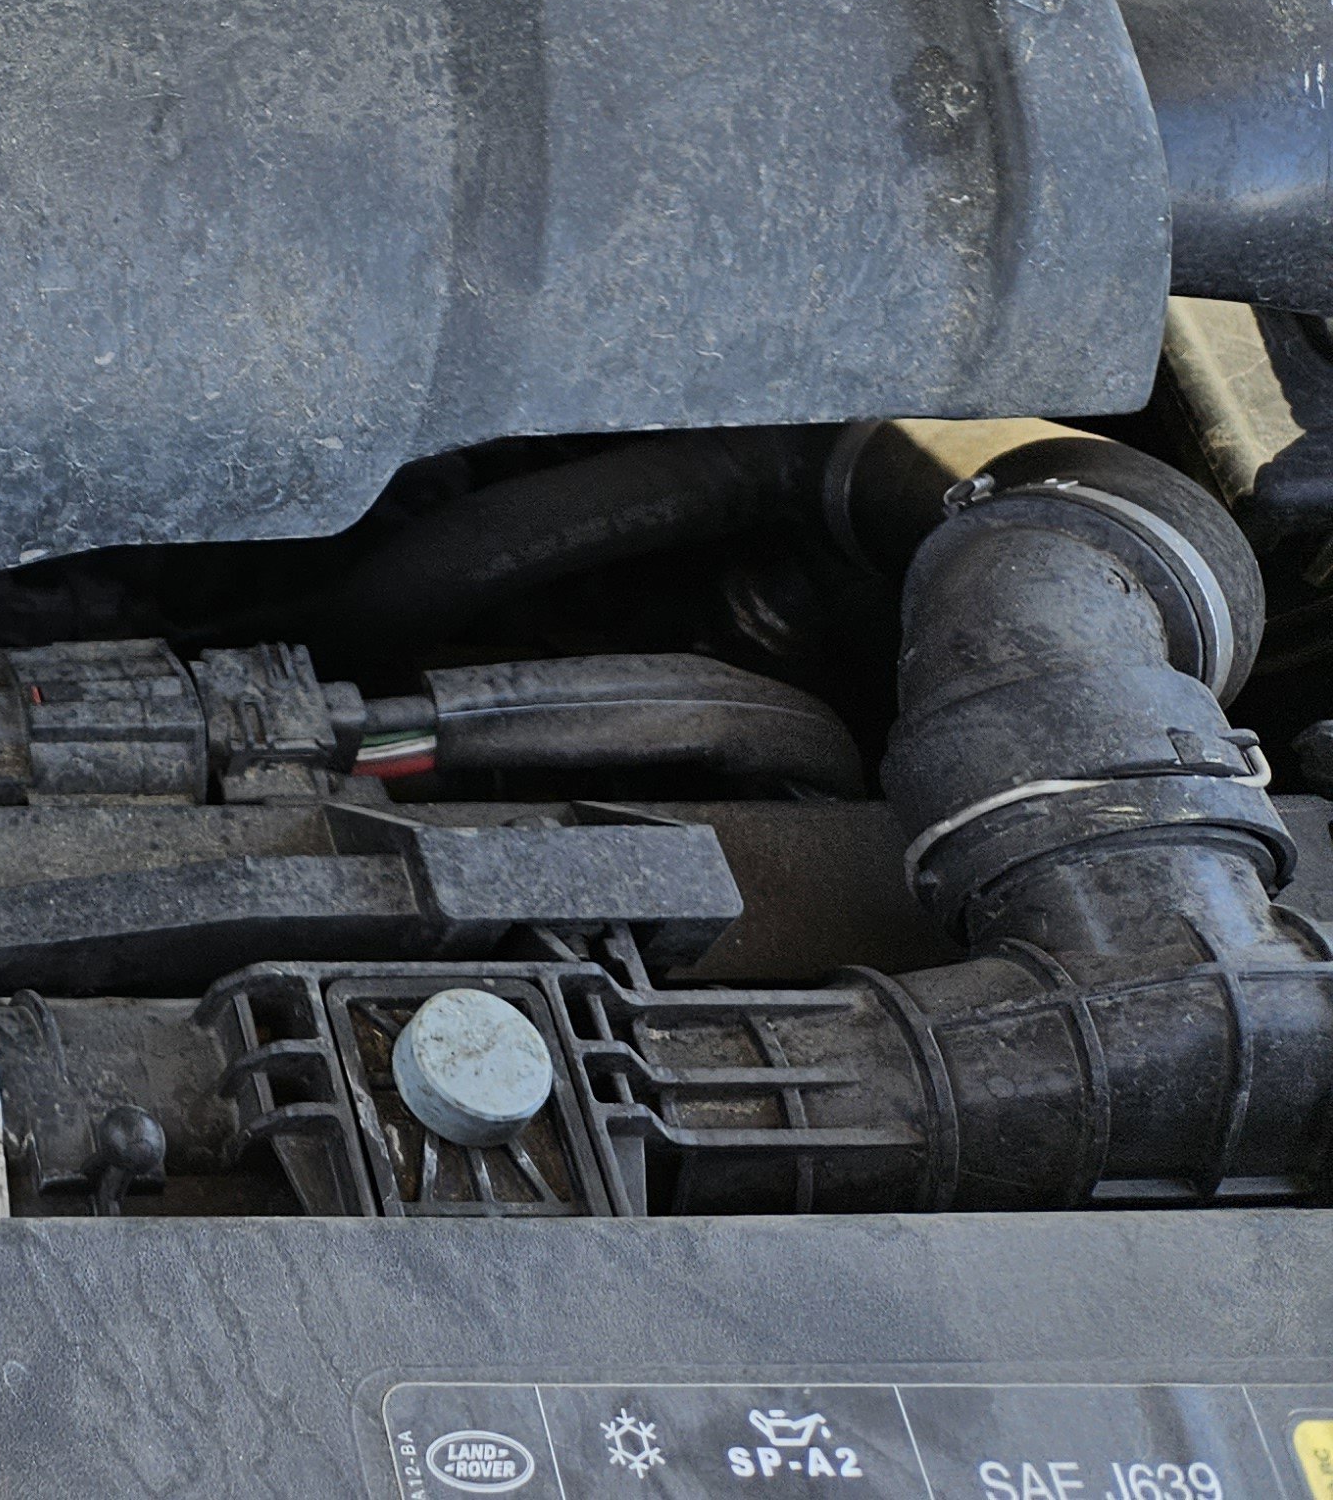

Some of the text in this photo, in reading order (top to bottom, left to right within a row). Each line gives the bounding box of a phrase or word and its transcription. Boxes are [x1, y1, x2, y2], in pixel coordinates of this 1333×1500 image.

[448, 1444, 496, 1461] LAND
[727, 1447, 863, 1477] SP-A2
[456, 1461, 516, 1478] ROVER
[1106, 1461, 1223, 1500] J639
